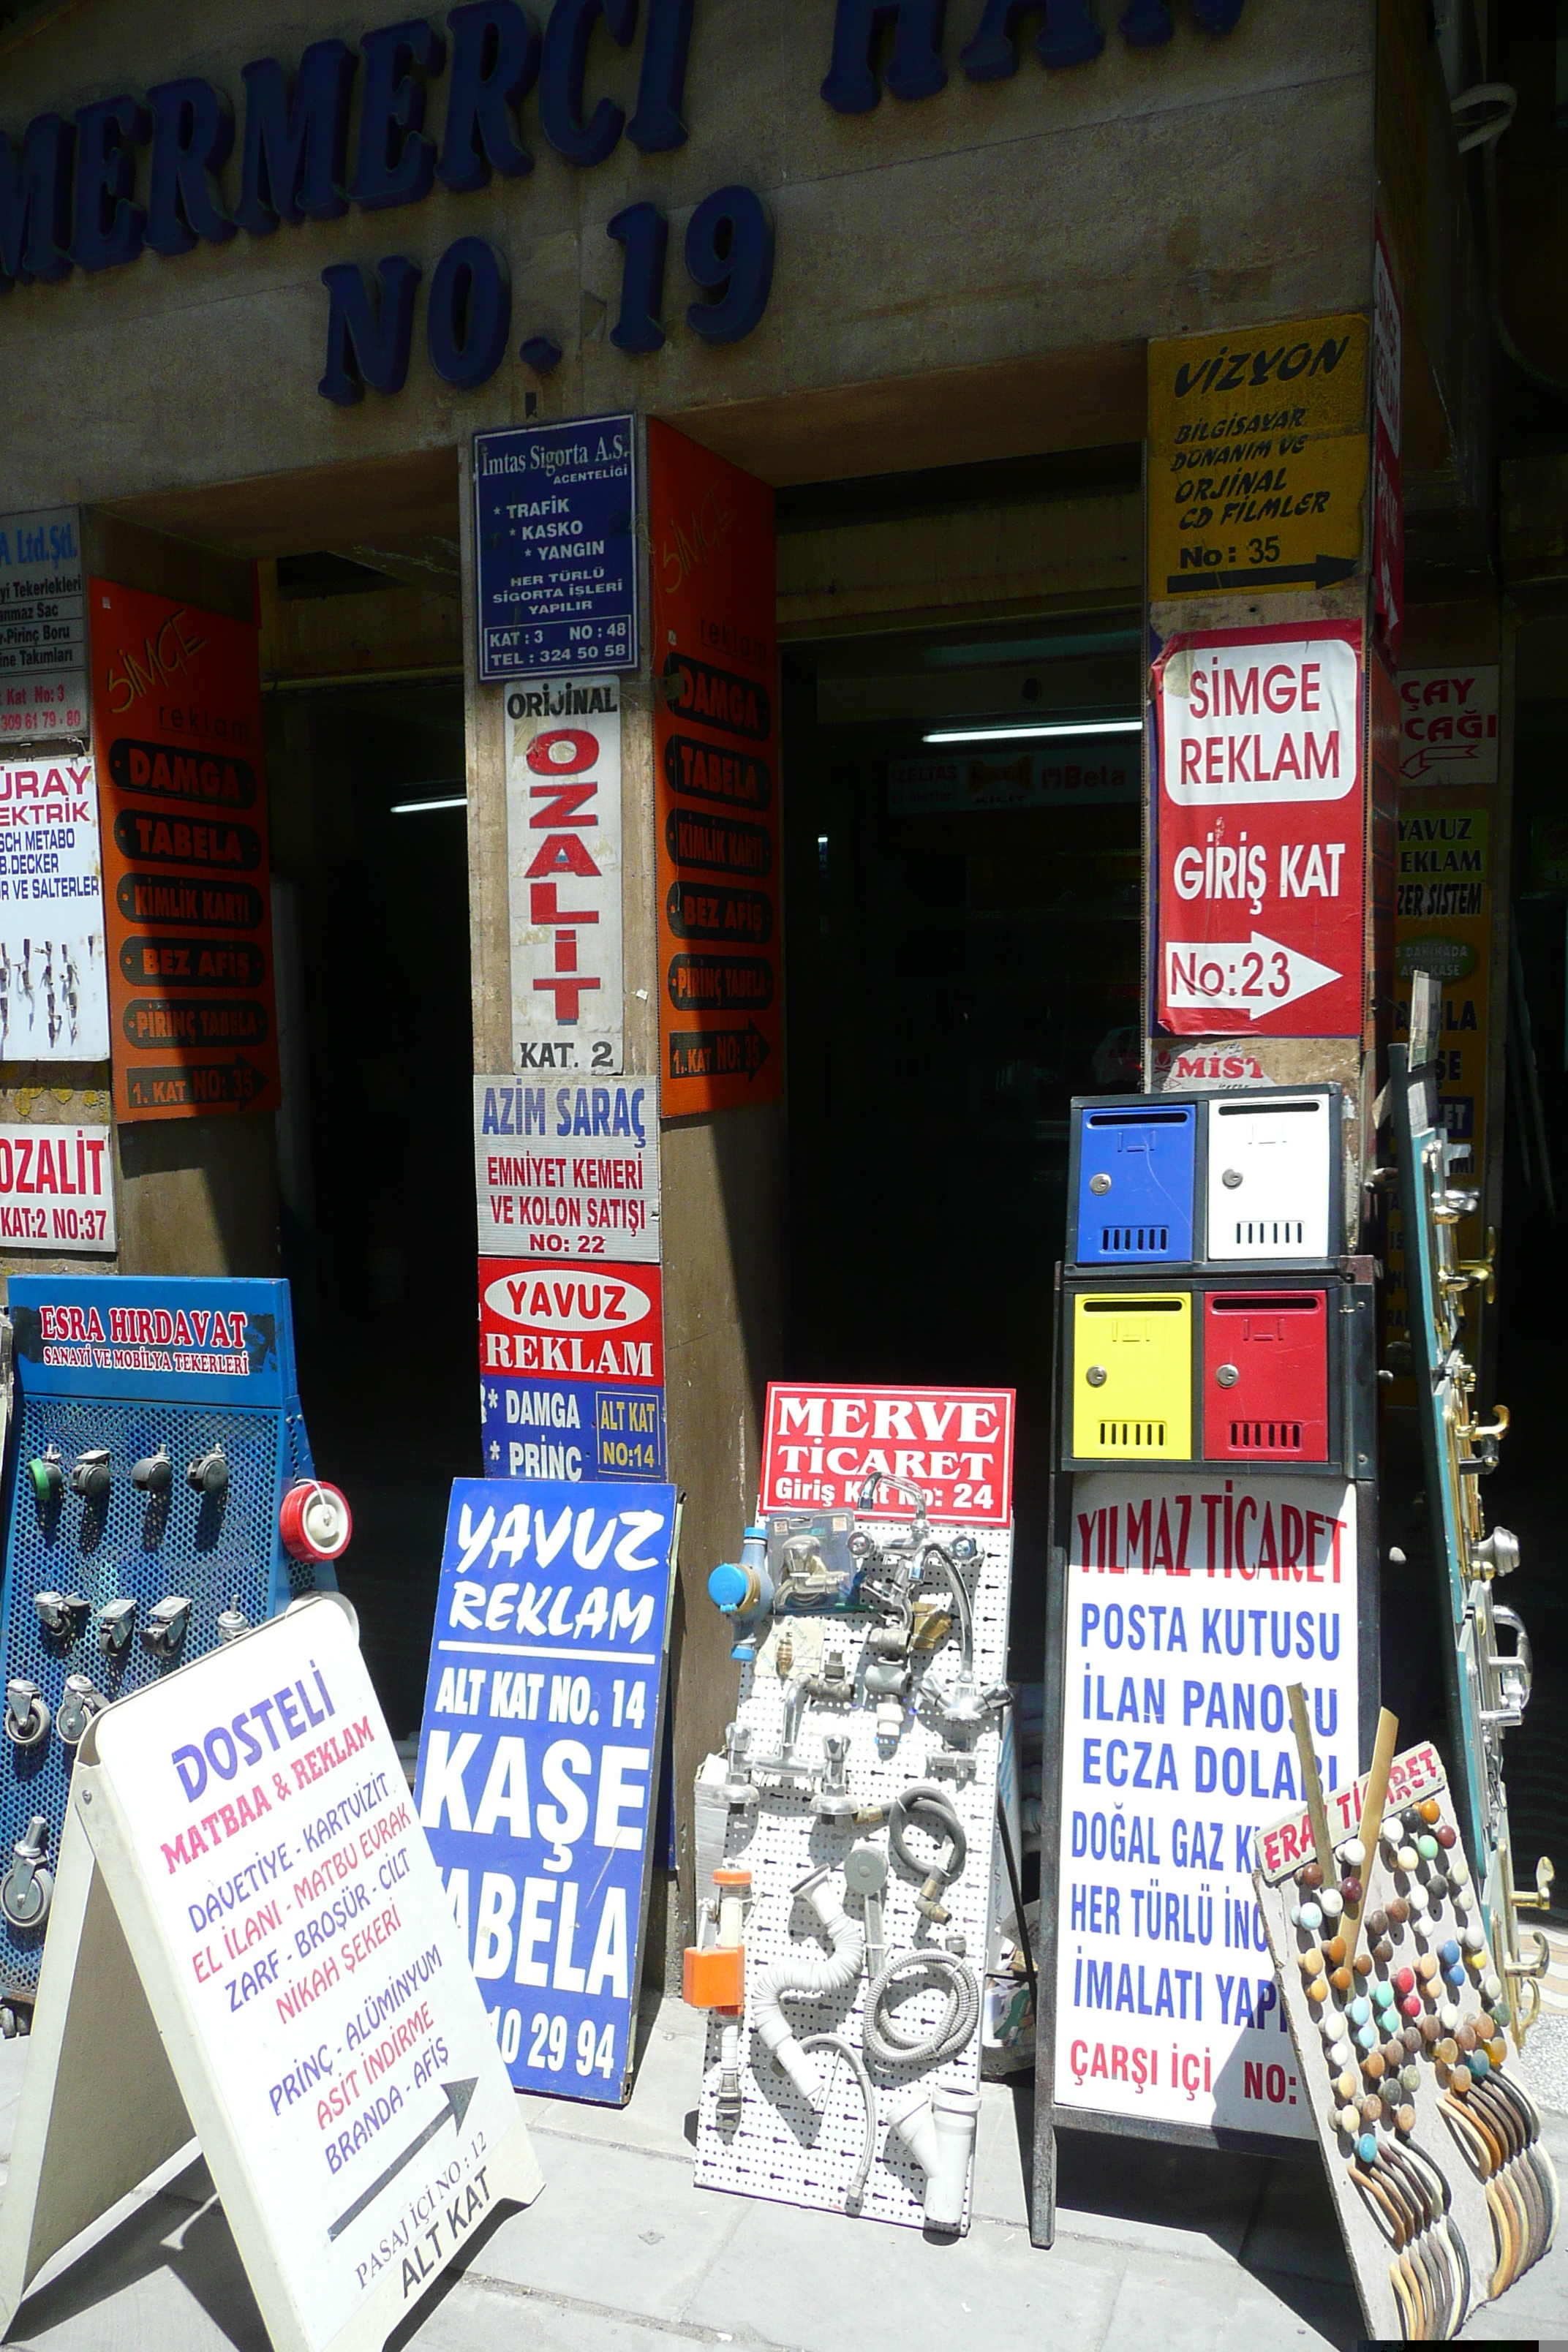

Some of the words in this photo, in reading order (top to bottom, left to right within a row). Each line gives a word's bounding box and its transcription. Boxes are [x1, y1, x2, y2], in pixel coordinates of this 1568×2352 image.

[317, 235, 563, 406] NO.
[608, 184, 776, 352] 19
[1174, 336, 1351, 398] VİZYON
[1174, 407, 1307, 444] BİLGİSAYAR
[1279, 434, 1308, 455] VE
[530, 443, 588, 478] Sigorta
[507, 495, 570, 519] TRAFİK
[1175, 467, 1287, 504] ORJİNAL
[522, 520, 584, 540] KASKO
[1180, 508, 1213, 530] CD
[1220, 491, 1331, 526] FİLMLER
[538, 540, 605, 561] YANGIN
[1248, 535, 1281, 564] 35
[13, 574, 81, 598] Tekerlekleri
[493, 587, 564, 603] SİGORTA
[569, 578, 623, 597] İŞLERİ
[510, 575, 543, 587] HER
[549, 566, 605, 583] TÜRLÜ
[37, 602, 59, 618] Sac
[528, 600, 592, 615] YAPILIR
[43, 625, 69, 640] Boru
[490, 632, 520, 647] KAT
[534, 630, 543, 644] 3
[607, 622, 627, 637] 48
[540, 648, 571, 663] 324
[578, 647, 599, 659] 50
[604, 644, 626, 657] 58
[20, 648, 72, 666] Takımları
[108, 609, 208, 713] SİMGE
[7, 687, 26, 705] Kat
[58, 683, 64, 702] 3
[678, 664, 759, 731] DAMGA
[1189, 657, 1321, 719] SİMGE
[1401, 678, 1475, 711] ÇAY
[1, 712, 21, 731] 309
[42, 710, 56, 728] 79
[67, 709, 80, 727] 80
[159, 705, 250, 742] reklam
[1399, 710, 1497, 743] CAĞI
[129, 748, 242, 801] DAMGA
[680, 745, 759, 801] TABELA
[1180, 730, 1340, 785] REKLAM
[26, 828, 75, 851] METABO
[135, 818, 244, 864] TABELA
[12, 879, 29, 900] VE
[32, 875, 99, 900] SALTERLER
[524, 728, 603, 1026] OZALİT
[1174, 830, 1267, 916] GİRİŞ
[1279, 843, 1346, 899] KAT
[135, 876, 197, 921] KİMLİK
[683, 895, 720, 928] BEZ
[724, 894, 763, 941] AFİŞ
[143, 949, 191, 976] BEZ
[197, 946, 251, 986] AFİŞ
[677, 960, 723, 1006] PİRİNÇ
[136, 1003, 197, 1045] PİRİNÇ
[200, 1011, 257, 1038] TABELA
[520, 1042, 578, 1068] KAT.
[591, 1041, 614, 1067] 2
[687, 1047, 712, 1073] KAT
[153, 1081, 186, 1104] KAT
[232, 1068, 254, 1097] 35
[482, 1078, 546, 1135] AZİM
[557, 1088, 647, 1148] SARAÇ
[0, 1130, 105, 1196] OZALİT
[488, 1150, 566, 1187] EMNİYET
[573, 1152, 643, 1190] KEMERİ
[1, 1207, 48, 1239] KAT:2
[53, 1209, 107, 1241] NO:37
[490, 1195, 513, 1224] VE
[519, 1196, 581, 1226] KOLON
[587, 1197, 645, 1237] SATIŞI
[529, 1234, 570, 1252] NO:
[578, 1235, 606, 1253] 22
[507, 1280, 627, 1321] YAVUZ
[40, 1305, 104, 1342] ESRA
[110, 1308, 247, 1349] HIRDAVAT
[44, 1344, 91, 1367] SANAYİ
[94, 1349, 111, 1368] VE
[113, 1346, 171, 1371] MOBİLYA
[175, 1350, 249, 1375] TEKERLERİ
[485, 1333, 655, 1377] REKLAM
[506, 1390, 581, 1429] DAMGA
[600, 1400, 625, 1431] ALT
[629, 1402, 655, 1433] KAT
[777, 1397, 1000, 1443] MERVE
[603, 1441, 655, 1468] NO:14
[777, 1437, 995, 1481] TİCARET
[775, 1477, 835, 1507] Giriş
[953, 1483, 994, 1509] 24
[456, 1503, 665, 1573] YAVUZ
[1077, 1494, 1192, 1577] YILMAZ
[1201, 1480, 1347, 1583] TİCARET
[449, 1580, 655, 1644] REKLAM
[1082, 1603, 1188, 1653] POSTA
[1202, 1607, 1340, 1661] KUTUSU
[434, 1667, 486, 1716] ALT
[489, 1670, 545, 1721] KAT
[548, 1675, 600, 1726] NO.
[612, 1680, 646, 1730] 14
[1083, 1663, 1166, 1725] İLAN
[171, 1659, 336, 1803] DOSTELİ
[1083, 1738, 1179, 1791] ECZA
[160, 1784, 272, 1874] MATBAA
[272, 1772, 292, 1801] &
[290, 1715, 375, 1790] REKLAM
[420, 1729, 651, 1874] KAŞE
[188, 1842, 293, 1933] DAVETİYE
[303, 1771, 389, 1853] KARTVİZİT
[1072, 1801, 1161, 1865] DOĞAL
[1172, 1818, 1224, 1872] GAZ
[192, 1946, 223, 1983] EL
[221, 1900, 283, 1960] İLANI
[293, 1842, 358, 1910] MATBU
[359, 1802, 412, 1860] EVRAK
[1071, 1883, 1120, 1936] HER
[1131, 1878, 1213, 1945] TÜRLÜ
[225, 1949, 279, 2013] ZARF
[294, 1883, 370, 1959] BROŞÜR
[379, 1847, 411, 1890] CİLT
[276, 1956, 341, 2024] NİKAH
[342, 1897, 402, 1974] ŞEKERİ
[1074, 1945, 1202, 2022] İMALATI
[268, 2043, 333, 2117] PRİNÇ
[346, 1944, 442, 2050] ALÜMİNYUM
[527, 2011, 568, 2072] 29
[576, 2019, 615, 2079] 94
[317, 2070, 361, 2130] ASİT
[361, 2001, 434, 2085] İNDİRME
[1070, 2039, 1157, 2094] ÇARŞI
[1171, 2043, 1212, 2101] İÇİ
[1245, 2060, 1297, 2105] NO:
[325, 2085, 404, 2175] BRANDA
[414, 2036, 450, 2089] AFİŞ
[354, 2219, 411, 2290] PASAJ
[407, 2184, 437, 2229] İÇİ
[472, 2131, 488, 2160] 12
[404, 2221, 444, 2299] ALT
[445, 2166, 491, 2239] KAT
